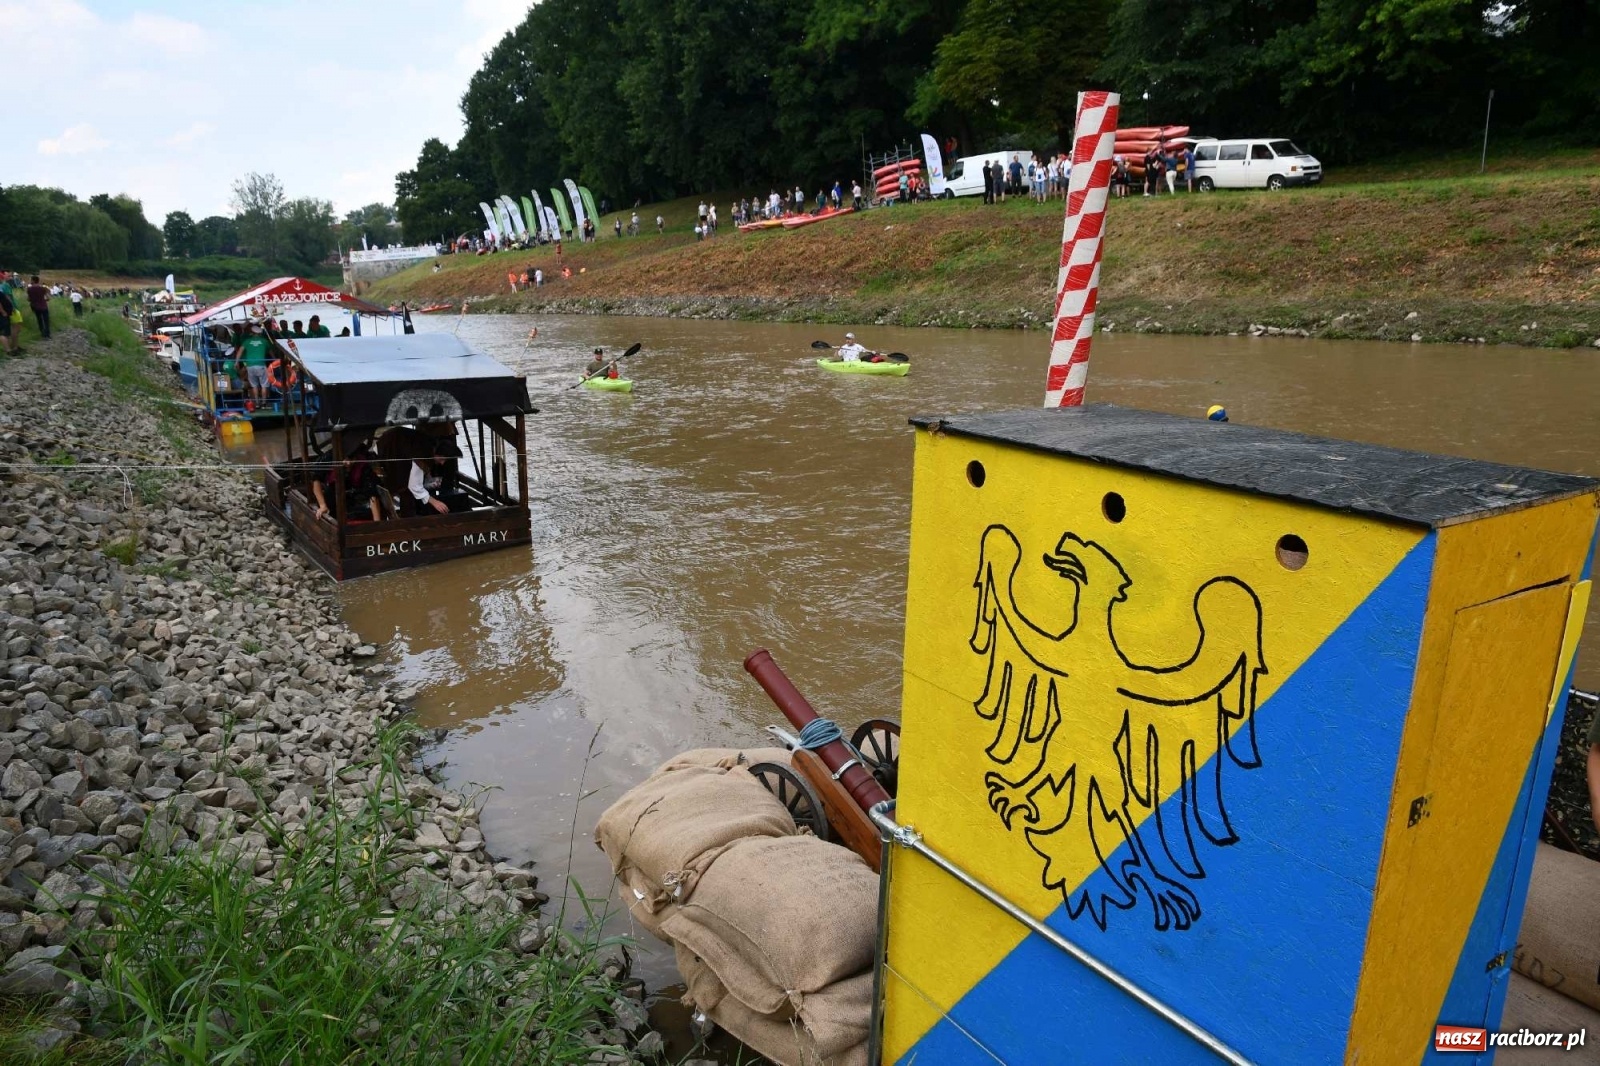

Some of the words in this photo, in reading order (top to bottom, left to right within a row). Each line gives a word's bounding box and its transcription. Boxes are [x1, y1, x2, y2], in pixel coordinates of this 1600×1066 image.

[254, 291, 341, 305] BŁAŻEJOWICE
[366, 539, 422, 557] BLACK
[463, 530, 508, 546] MARY
